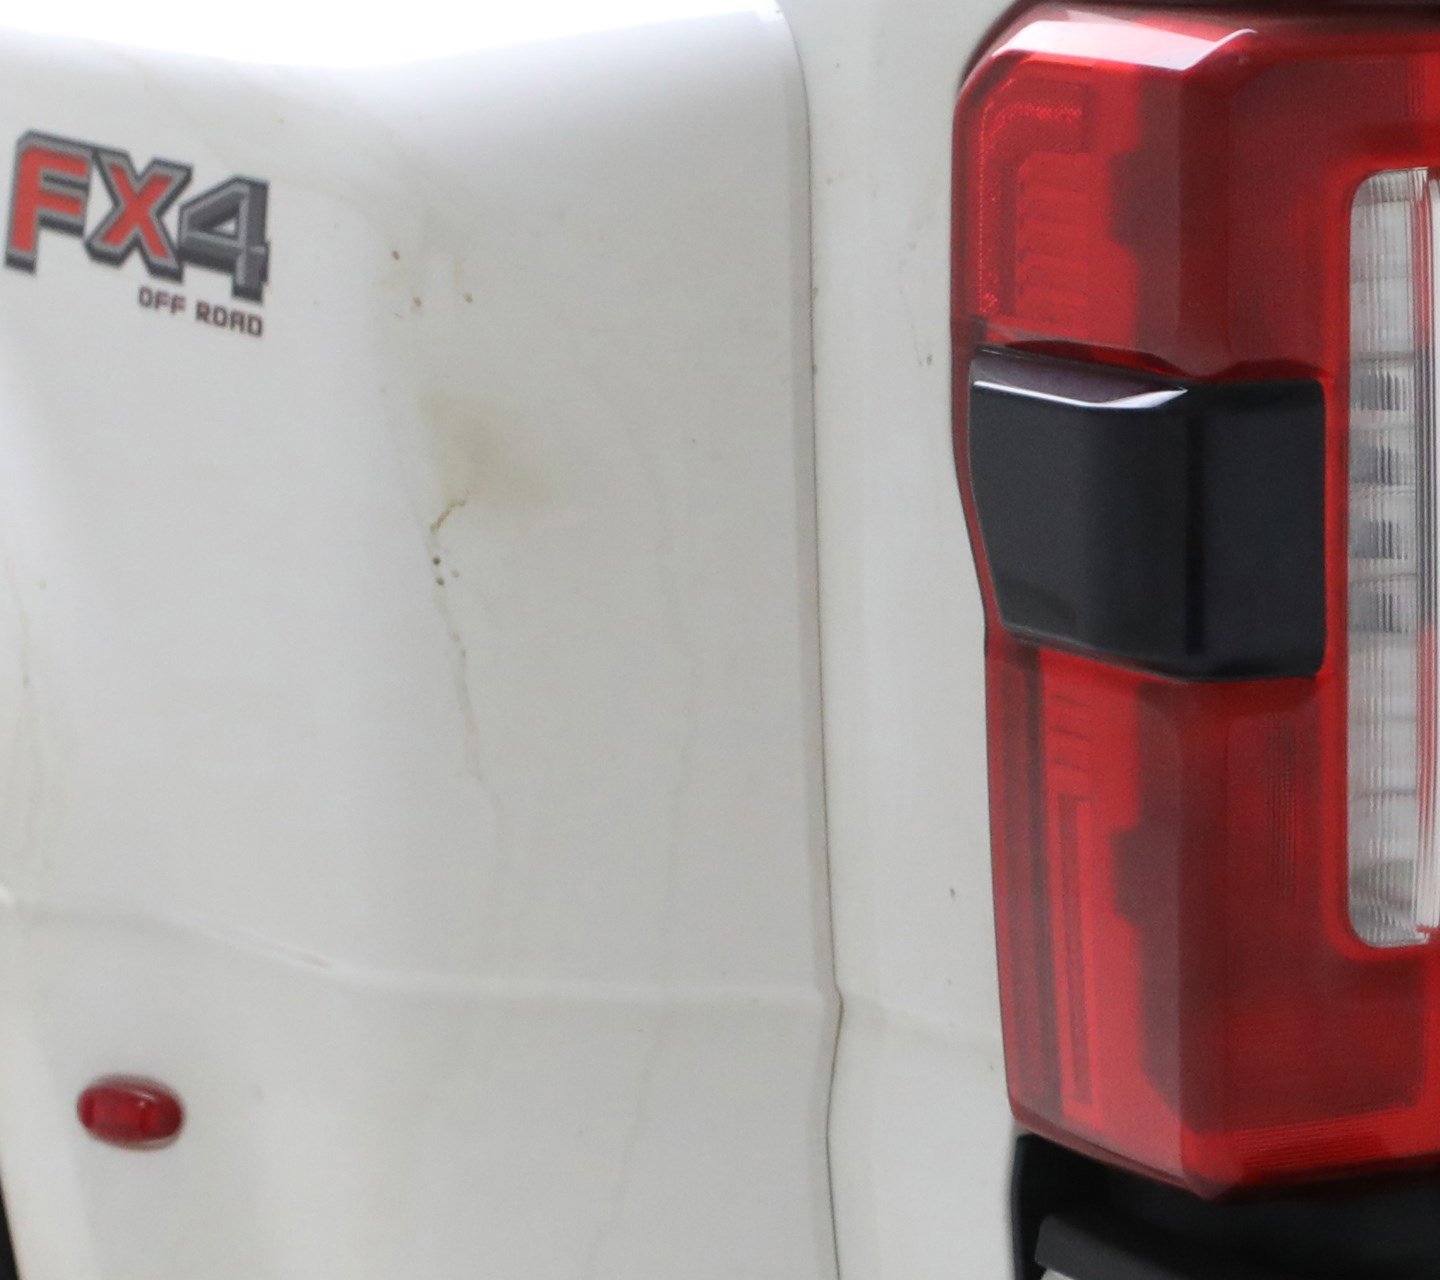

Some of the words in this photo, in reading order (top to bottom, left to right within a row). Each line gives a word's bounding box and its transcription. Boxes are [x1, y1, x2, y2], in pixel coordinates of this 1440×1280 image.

[4, 128, 270, 305] FX4
[138, 286, 187, 315] OFF
[195, 300, 265, 338] ROAD
